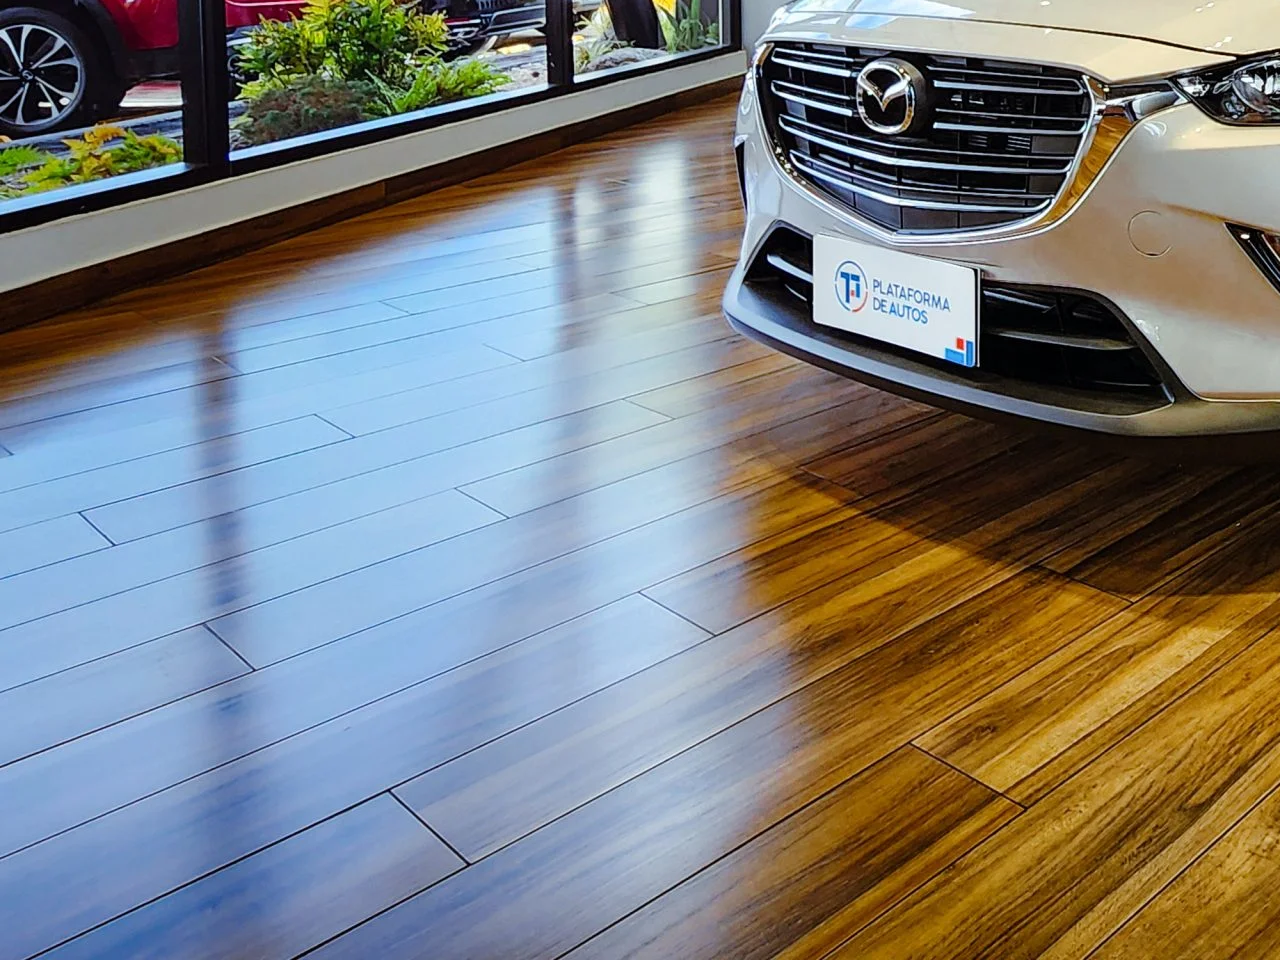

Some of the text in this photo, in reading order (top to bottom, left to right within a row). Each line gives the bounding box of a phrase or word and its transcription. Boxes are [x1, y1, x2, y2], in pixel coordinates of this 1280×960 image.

[872, 279, 951, 312] PLATAFORMA
[872, 297, 929, 325] DE AUTOS
